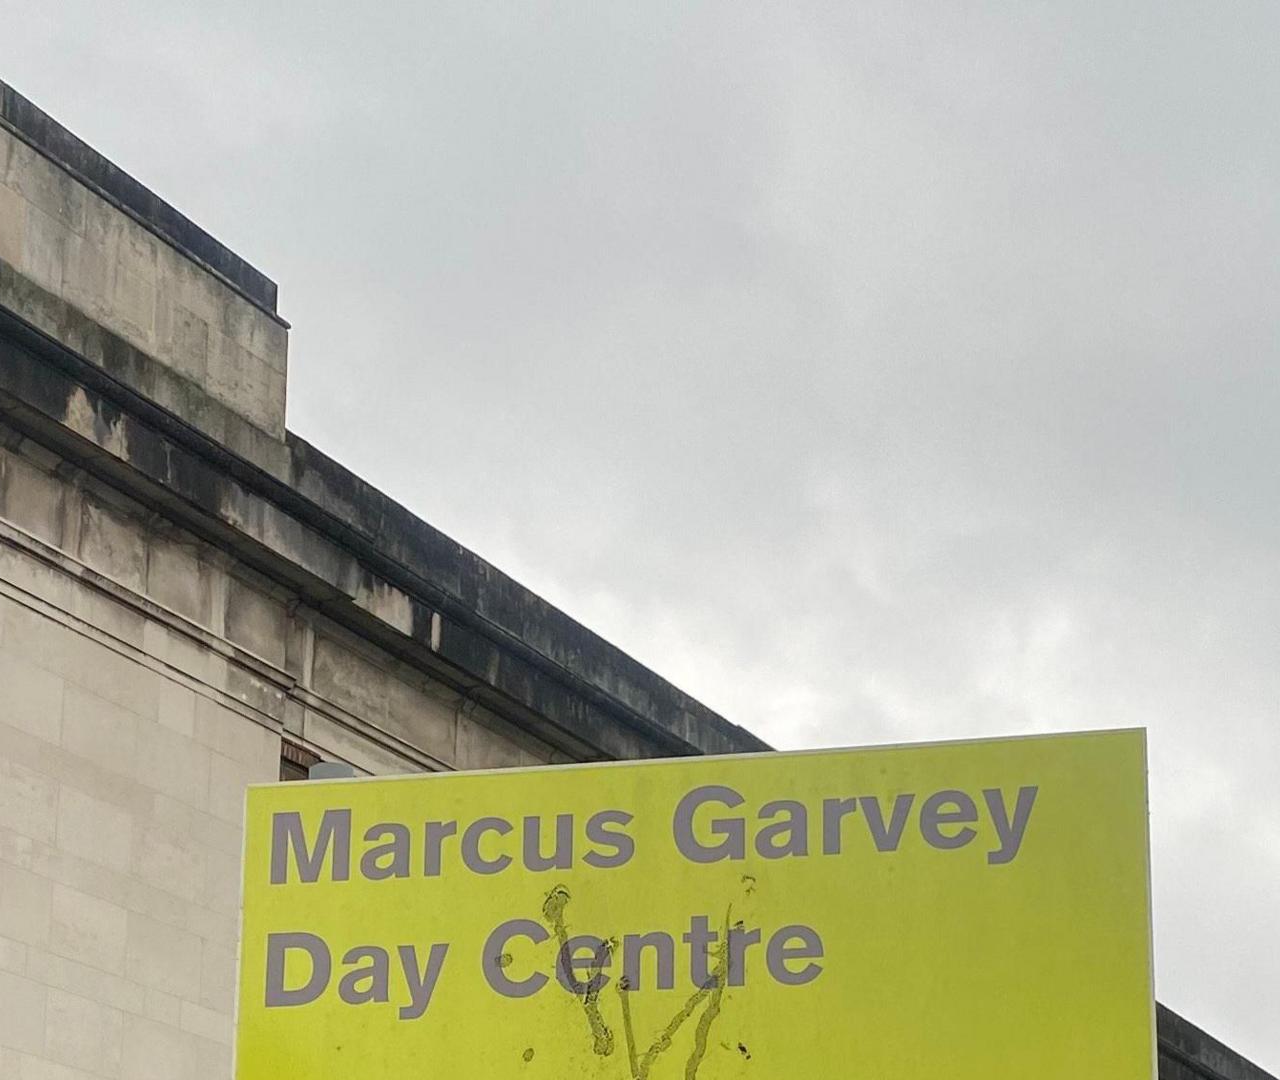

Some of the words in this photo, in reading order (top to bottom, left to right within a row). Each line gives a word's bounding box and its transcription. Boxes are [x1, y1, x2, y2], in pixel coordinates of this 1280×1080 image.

[269, 806, 636, 885] Marcus
[672, 784, 1040, 865] Garvey
[264, 930, 449, 1020] Day
[482, 914, 826, 999] Centre
